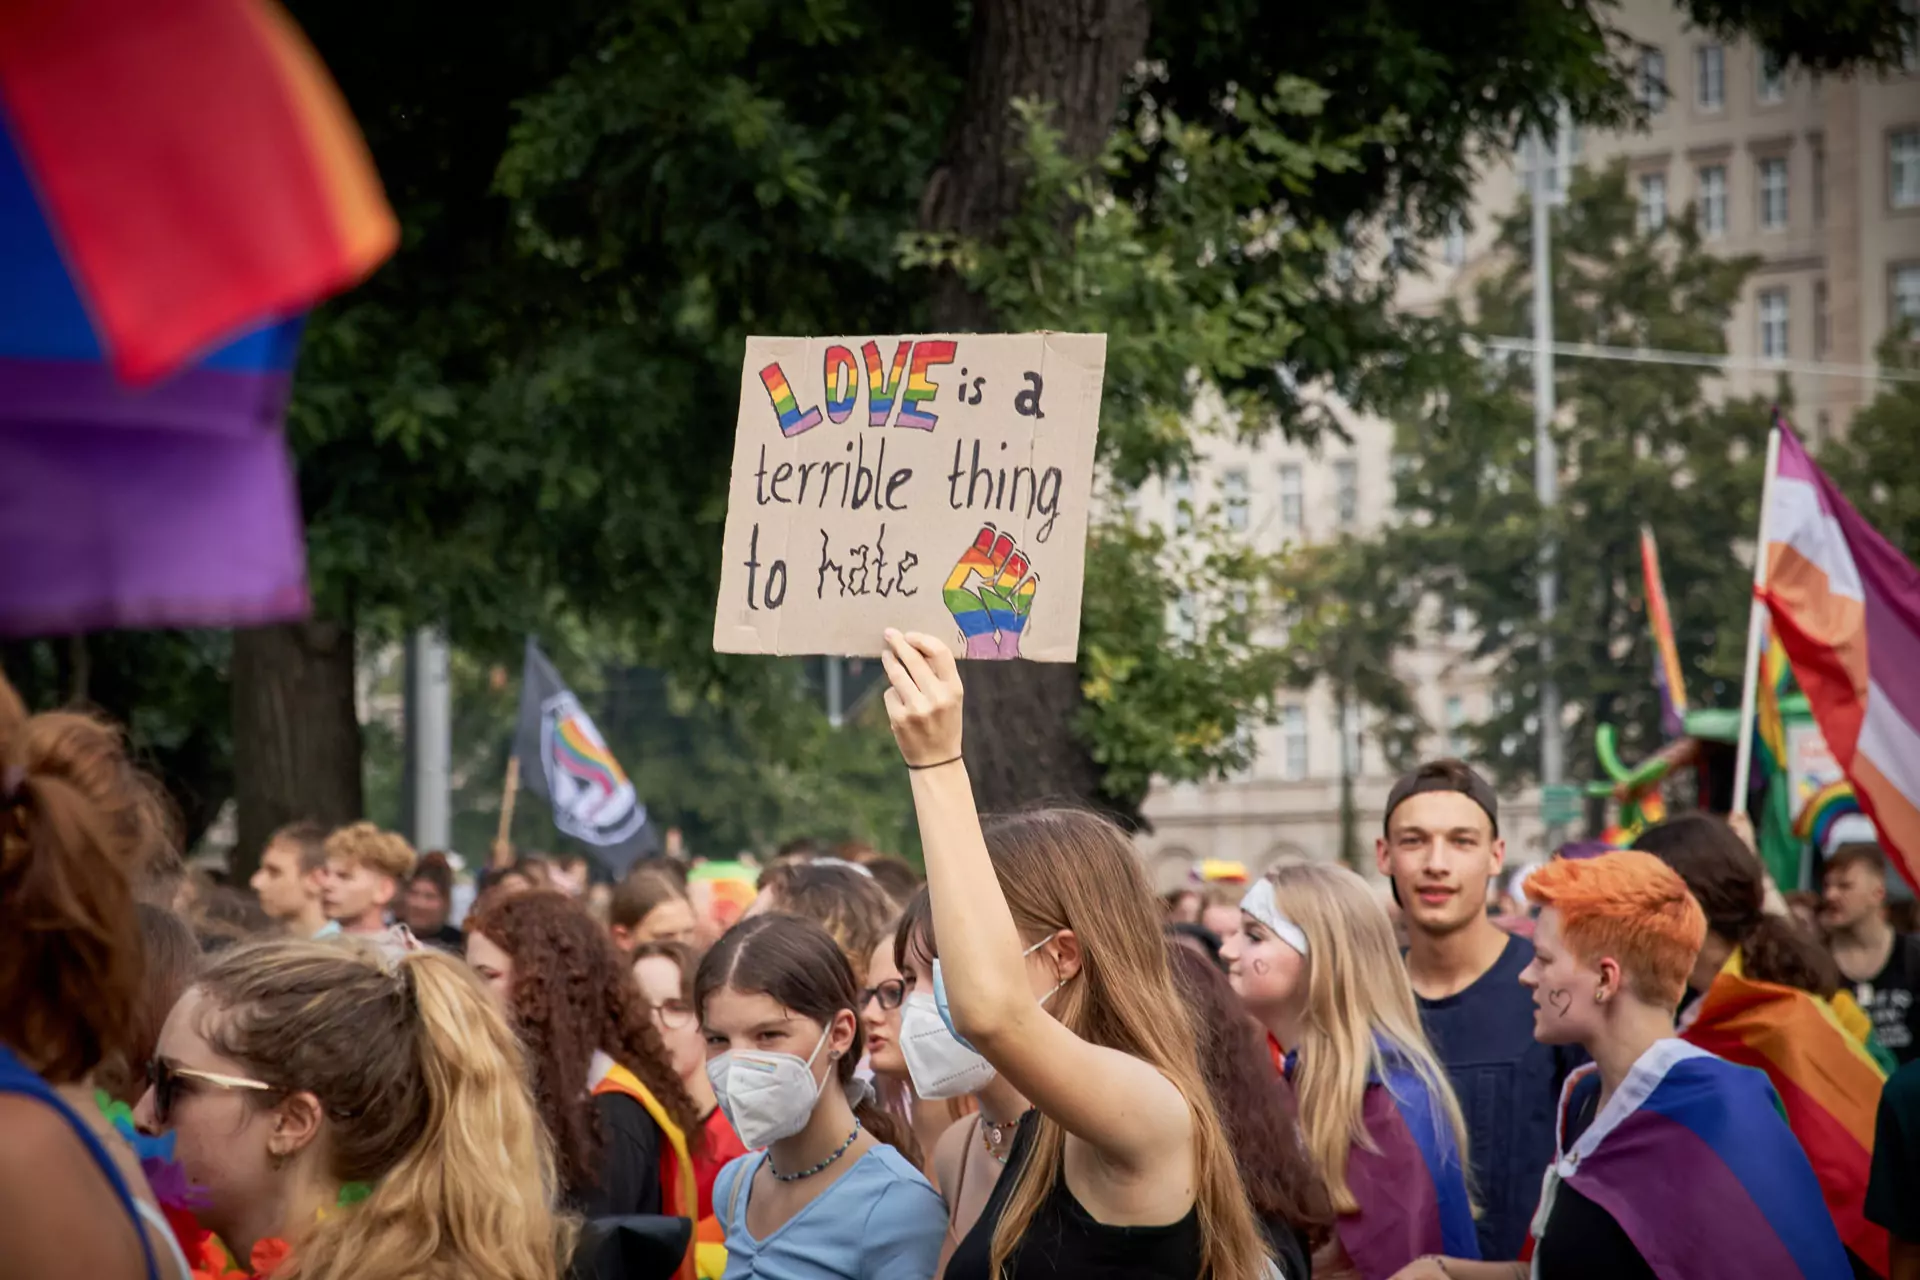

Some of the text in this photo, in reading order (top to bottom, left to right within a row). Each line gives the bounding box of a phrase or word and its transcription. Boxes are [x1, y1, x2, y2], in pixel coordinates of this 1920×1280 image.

[759, 340, 1045, 438] LOVE is a
[754, 432, 1062, 543] terrible thing
[743, 523, 918, 610] to hate
